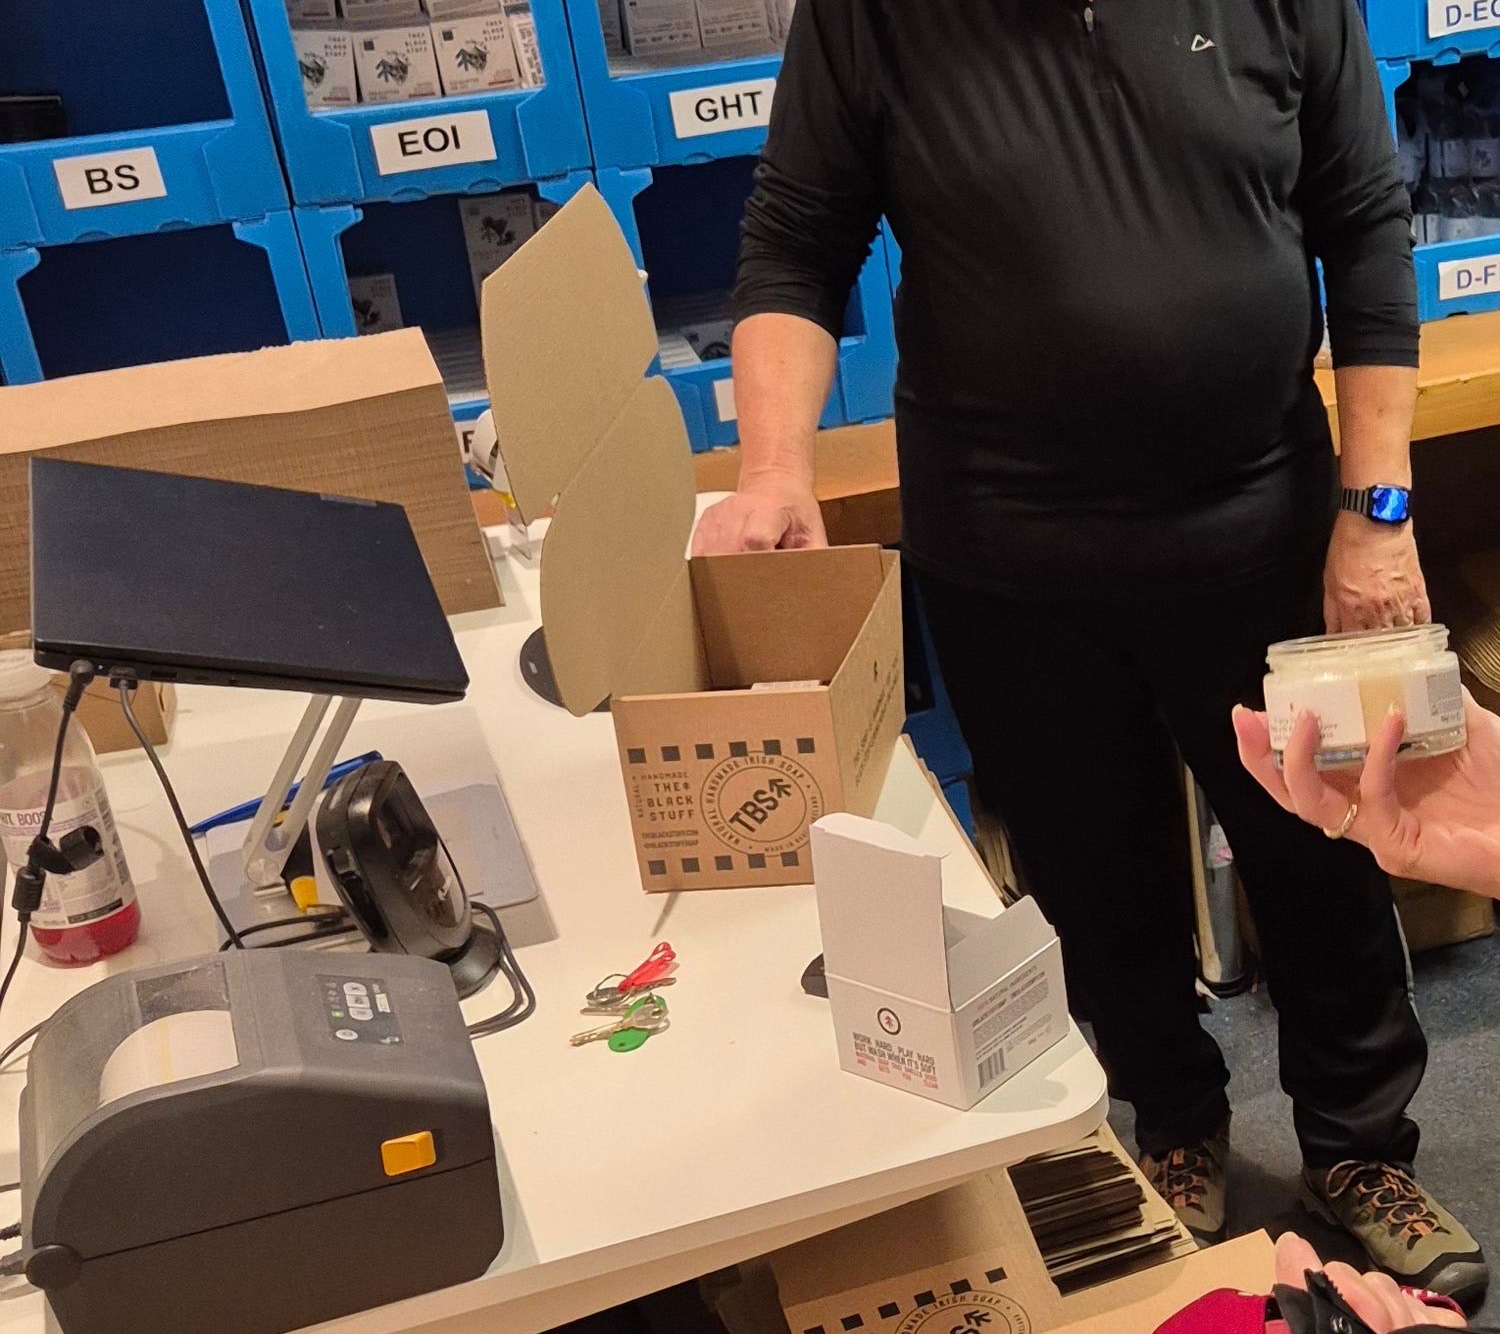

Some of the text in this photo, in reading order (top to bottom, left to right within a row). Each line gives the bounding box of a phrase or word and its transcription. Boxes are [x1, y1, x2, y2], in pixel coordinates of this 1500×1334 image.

[694, 91, 764, 124] GHT
[397, 126, 462, 157] EOI
[84, 165, 141, 195] BS
[641, 771, 690, 781] HANDMADE
[654, 783, 684, 793] THE
[647, 795, 694, 808] BLACK
[728, 789, 780, 834] TBS
[650, 809, 695, 822] STUFF
